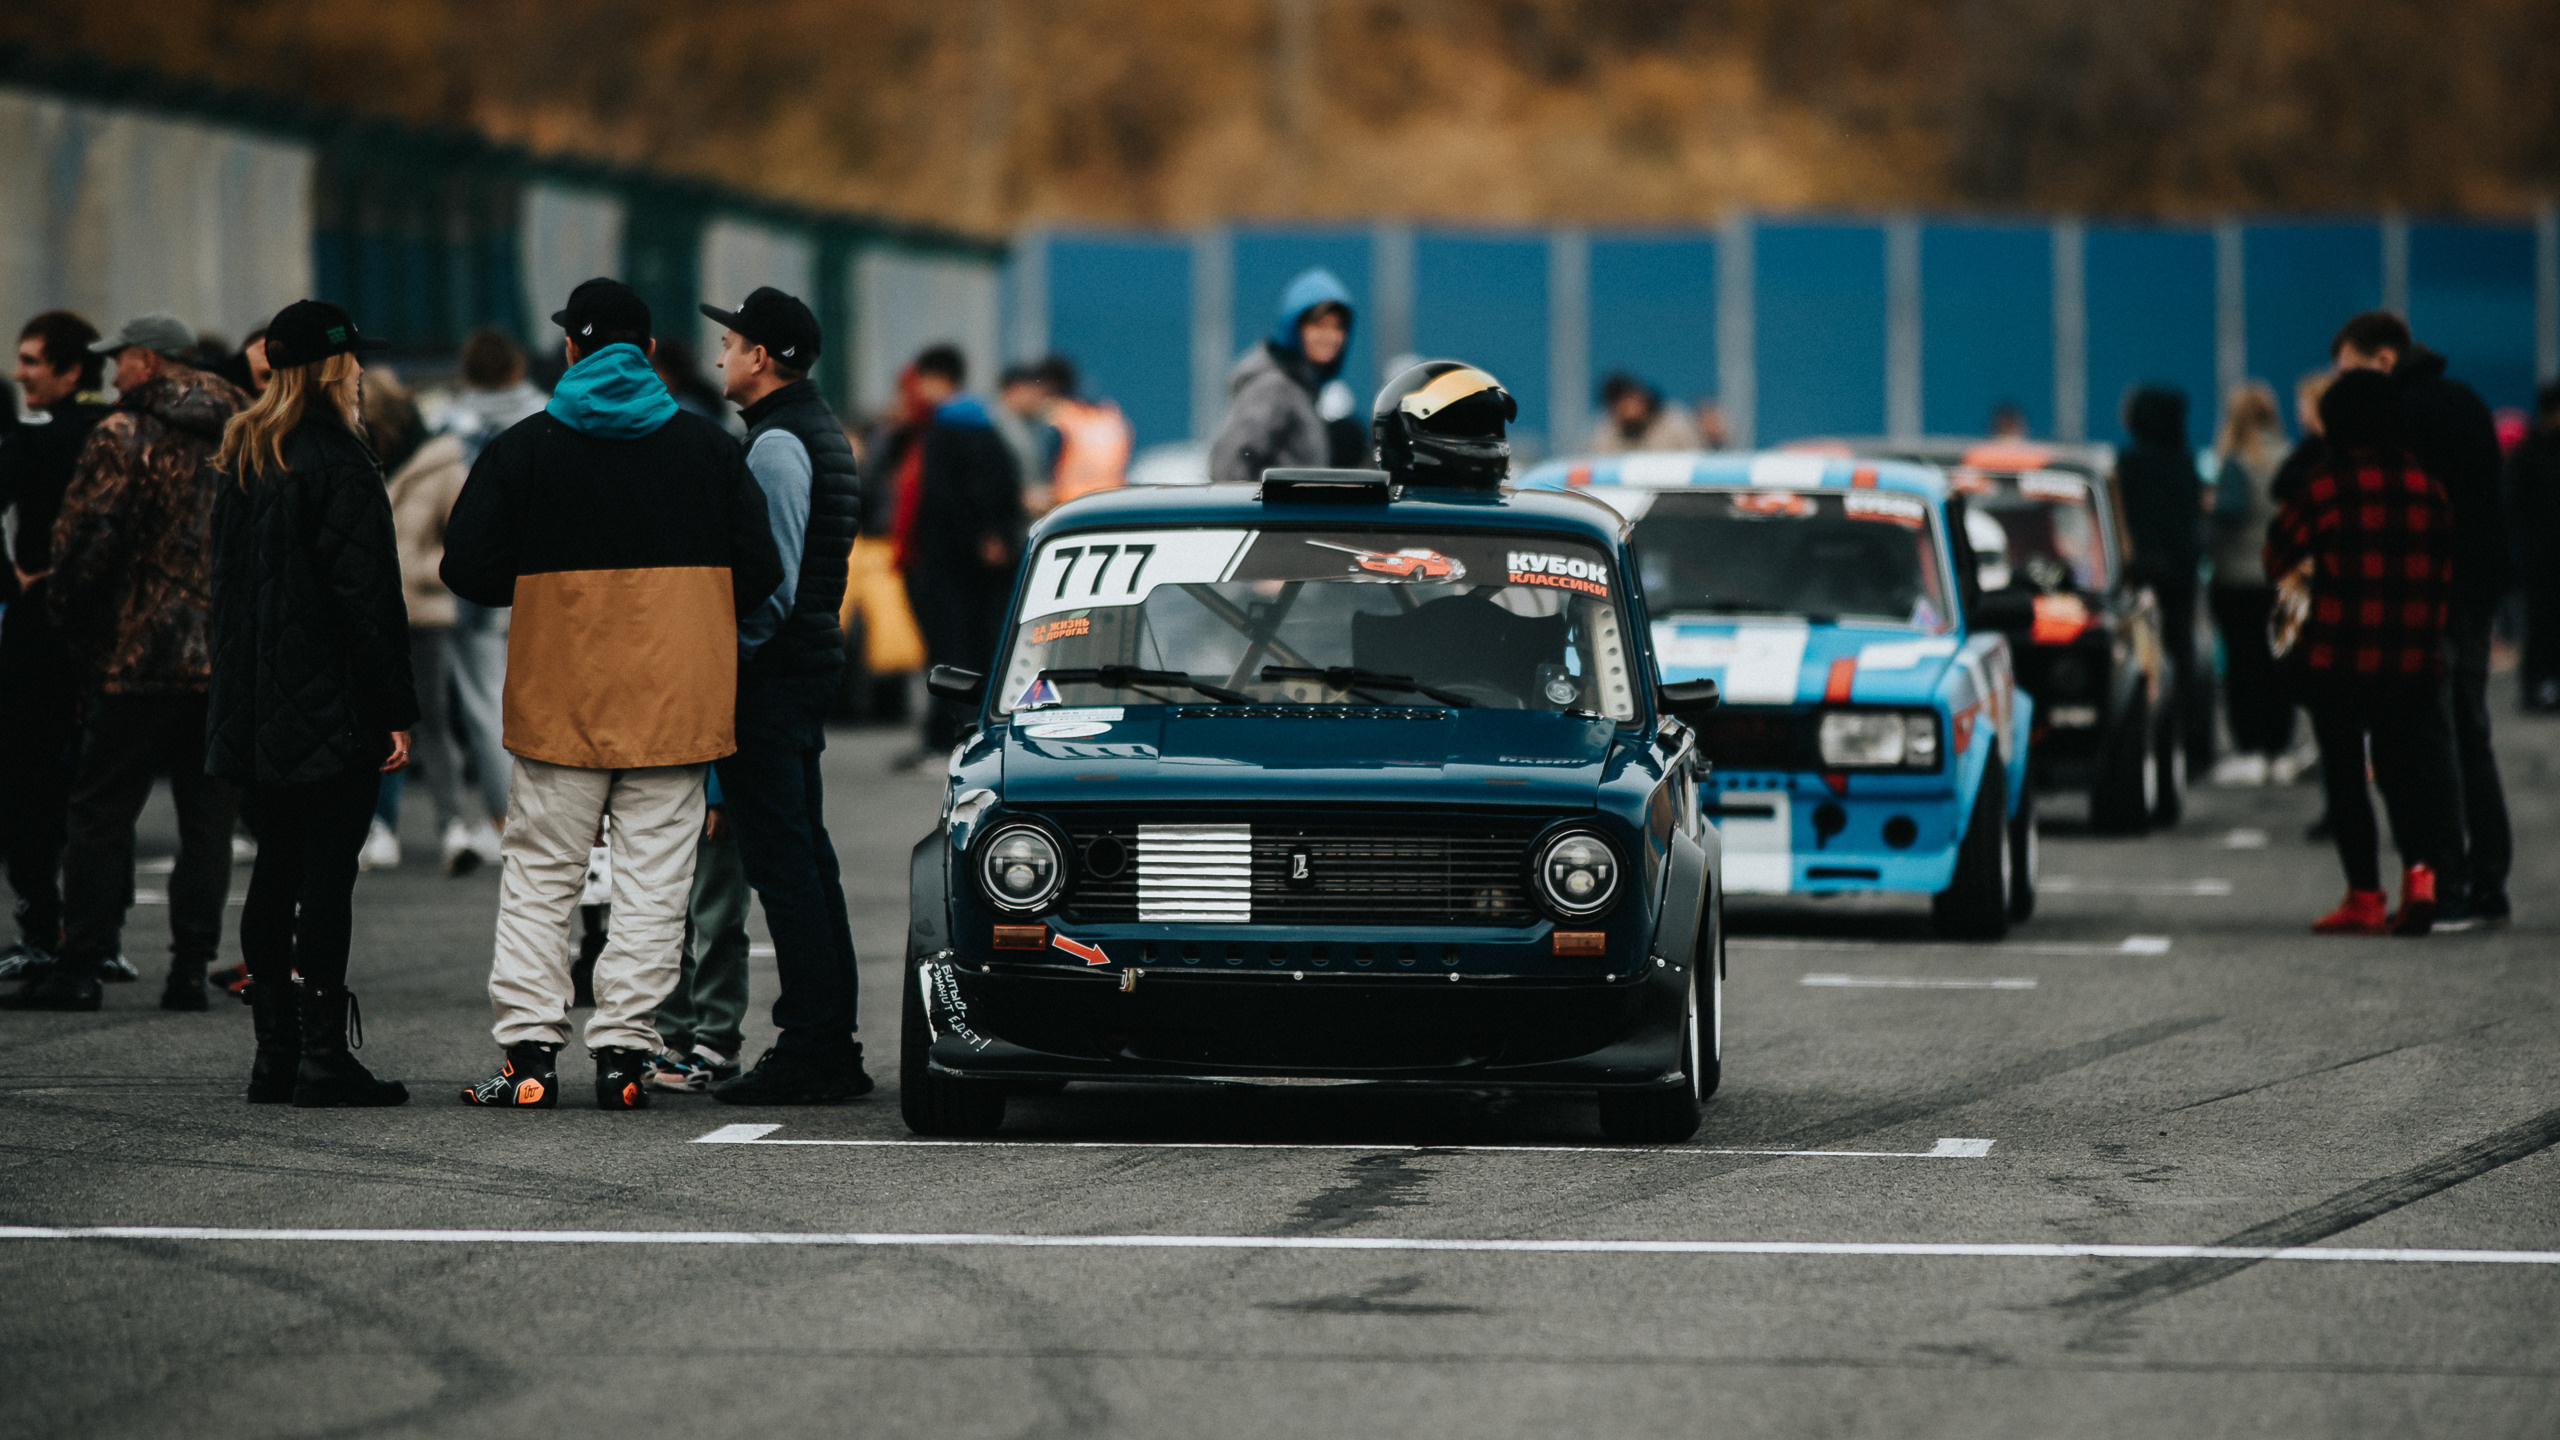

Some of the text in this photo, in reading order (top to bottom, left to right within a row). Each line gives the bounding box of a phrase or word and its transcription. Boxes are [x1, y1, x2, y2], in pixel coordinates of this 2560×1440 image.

[1054, 544, 1157, 600] 777
[1507, 551, 1608, 584] КУБОК
[1508, 572, 1608, 598] КЛАССИКИ
[1045, 627, 1090, 642] ДОРОГАХ
[1049, 617, 1091, 632] ЖИЗНЬ
[948, 1015, 992, 1052] ЕДЕТ!
